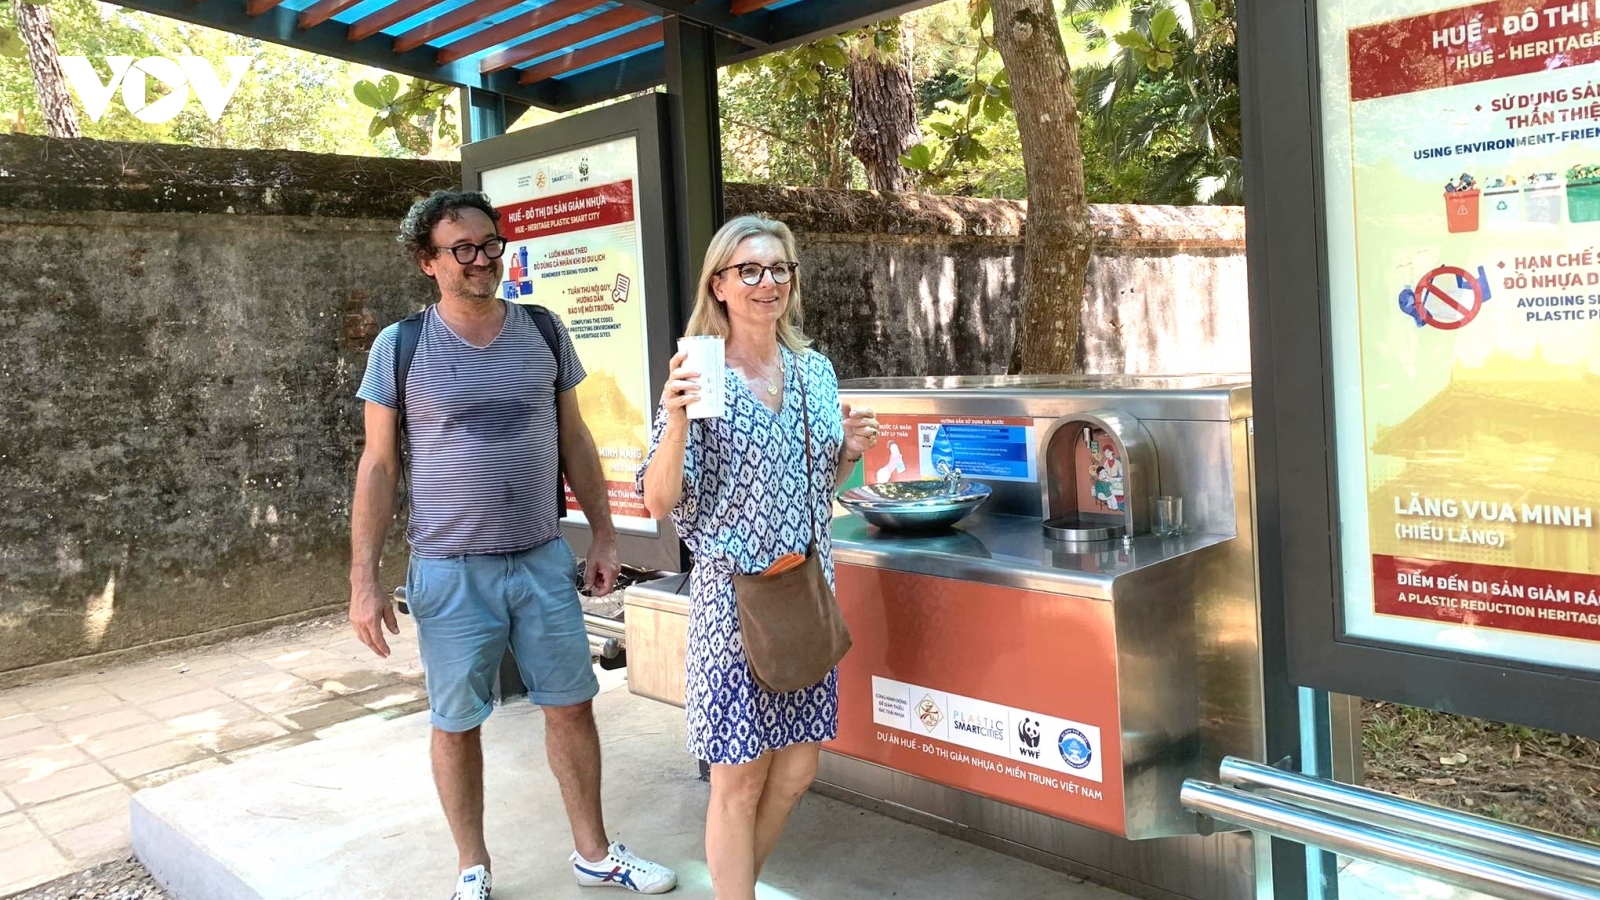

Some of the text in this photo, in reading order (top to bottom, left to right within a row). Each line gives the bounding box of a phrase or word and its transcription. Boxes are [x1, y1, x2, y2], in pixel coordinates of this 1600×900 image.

[1433, 13, 1484, 49] HUẾ
[1503, 7, 1538, 36] ĐÔ
[1543, 2, 1588, 28] THỊ
[1457, 49, 1494, 70] HUE
[1510, 31, 1600, 60] HERITAGE
[1491, 93, 1515, 112] SỬ
[1518, 89, 1568, 109] DỤNG
[1414, 146, 1452, 159] USING
[509, 208, 521, 223] HUẾ
[526, 207, 534, 219] ĐÔ
[535, 208, 546, 219] THỊ
[547, 206, 553, 215] DI
[554, 201, 567, 214] SẢN
[568, 198, 585, 211] GIẢM
[586, 193, 607, 209] NHỰA
[528, 222, 550, 231] HERITAGE
[551, 218, 570, 228] PLASTIC
[571, 214, 587, 224] SMART
[588, 212, 600, 220] CITY
[1515, 255, 1552, 273] HẠN
[1556, 246, 1594, 267] CHẾ
[1503, 271, 1527, 289] ĐỒ
[1532, 272, 1583, 290] NHỰA
[1517, 295, 1585, 308] AVOIDING
[1526, 310, 1585, 321] PLASTIC
[1394, 492, 1592, 528] LĂNG VUA MINH
[1395, 520, 1504, 548] (HIẾU LĂNG)
[1397, 569, 1600, 606] ĐIỂM ĐẾN DI SẢN GIẢM RÁ
[1398, 592, 1600, 625] A PLASTIC REDUCTION HERITAG
[954, 710, 1003, 731] PLASTIC
[954, 720, 1003, 740] SMARTCITIES
[1019, 747, 1040, 759] WWF
[877, 732, 888, 741] DỰ
[889, 733, 900, 745] ÁN
[901, 738, 916, 749] HUẾ
[922, 744, 934, 754] ĐÔ
[936, 748, 948, 759] THỊ
[972, 758, 995, 771] NHỰA
[997, 762, 1004, 773] Ở
[1028, 772, 1058, 789] TRUNG
[1060, 781, 1079, 794] VIỆT
[1081, 787, 1102, 801] NAM
